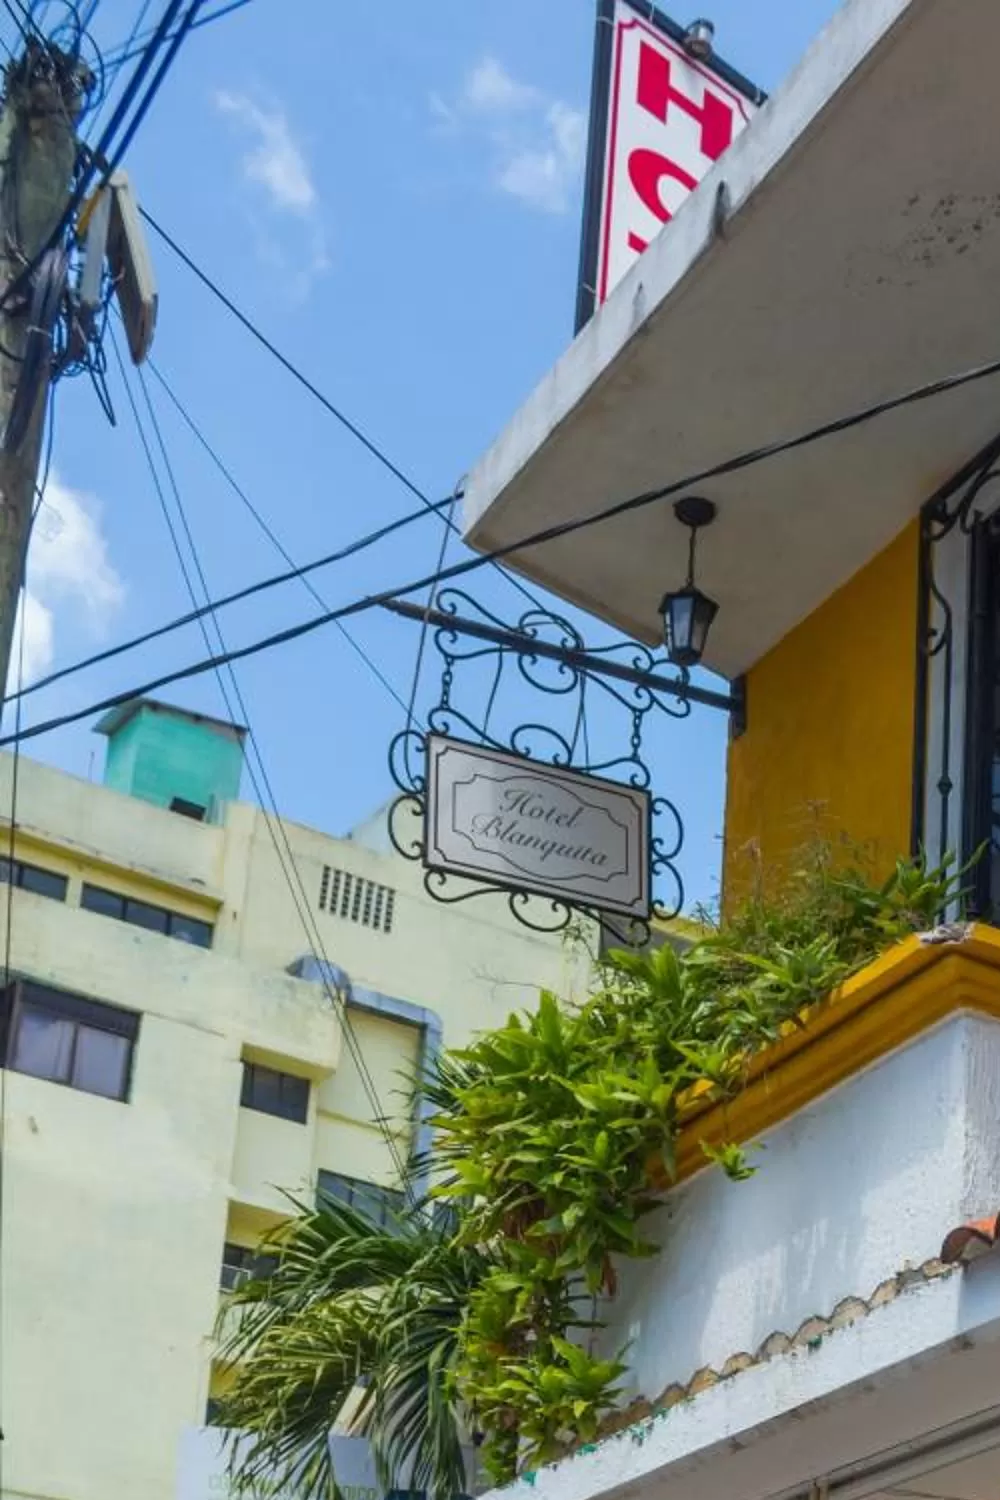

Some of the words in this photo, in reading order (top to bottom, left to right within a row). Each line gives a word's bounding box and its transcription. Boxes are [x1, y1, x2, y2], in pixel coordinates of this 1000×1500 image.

[628, 39, 733, 256] HO
[499, 788, 585, 829] Hotel
[471, 814, 609, 866] Blanquita
